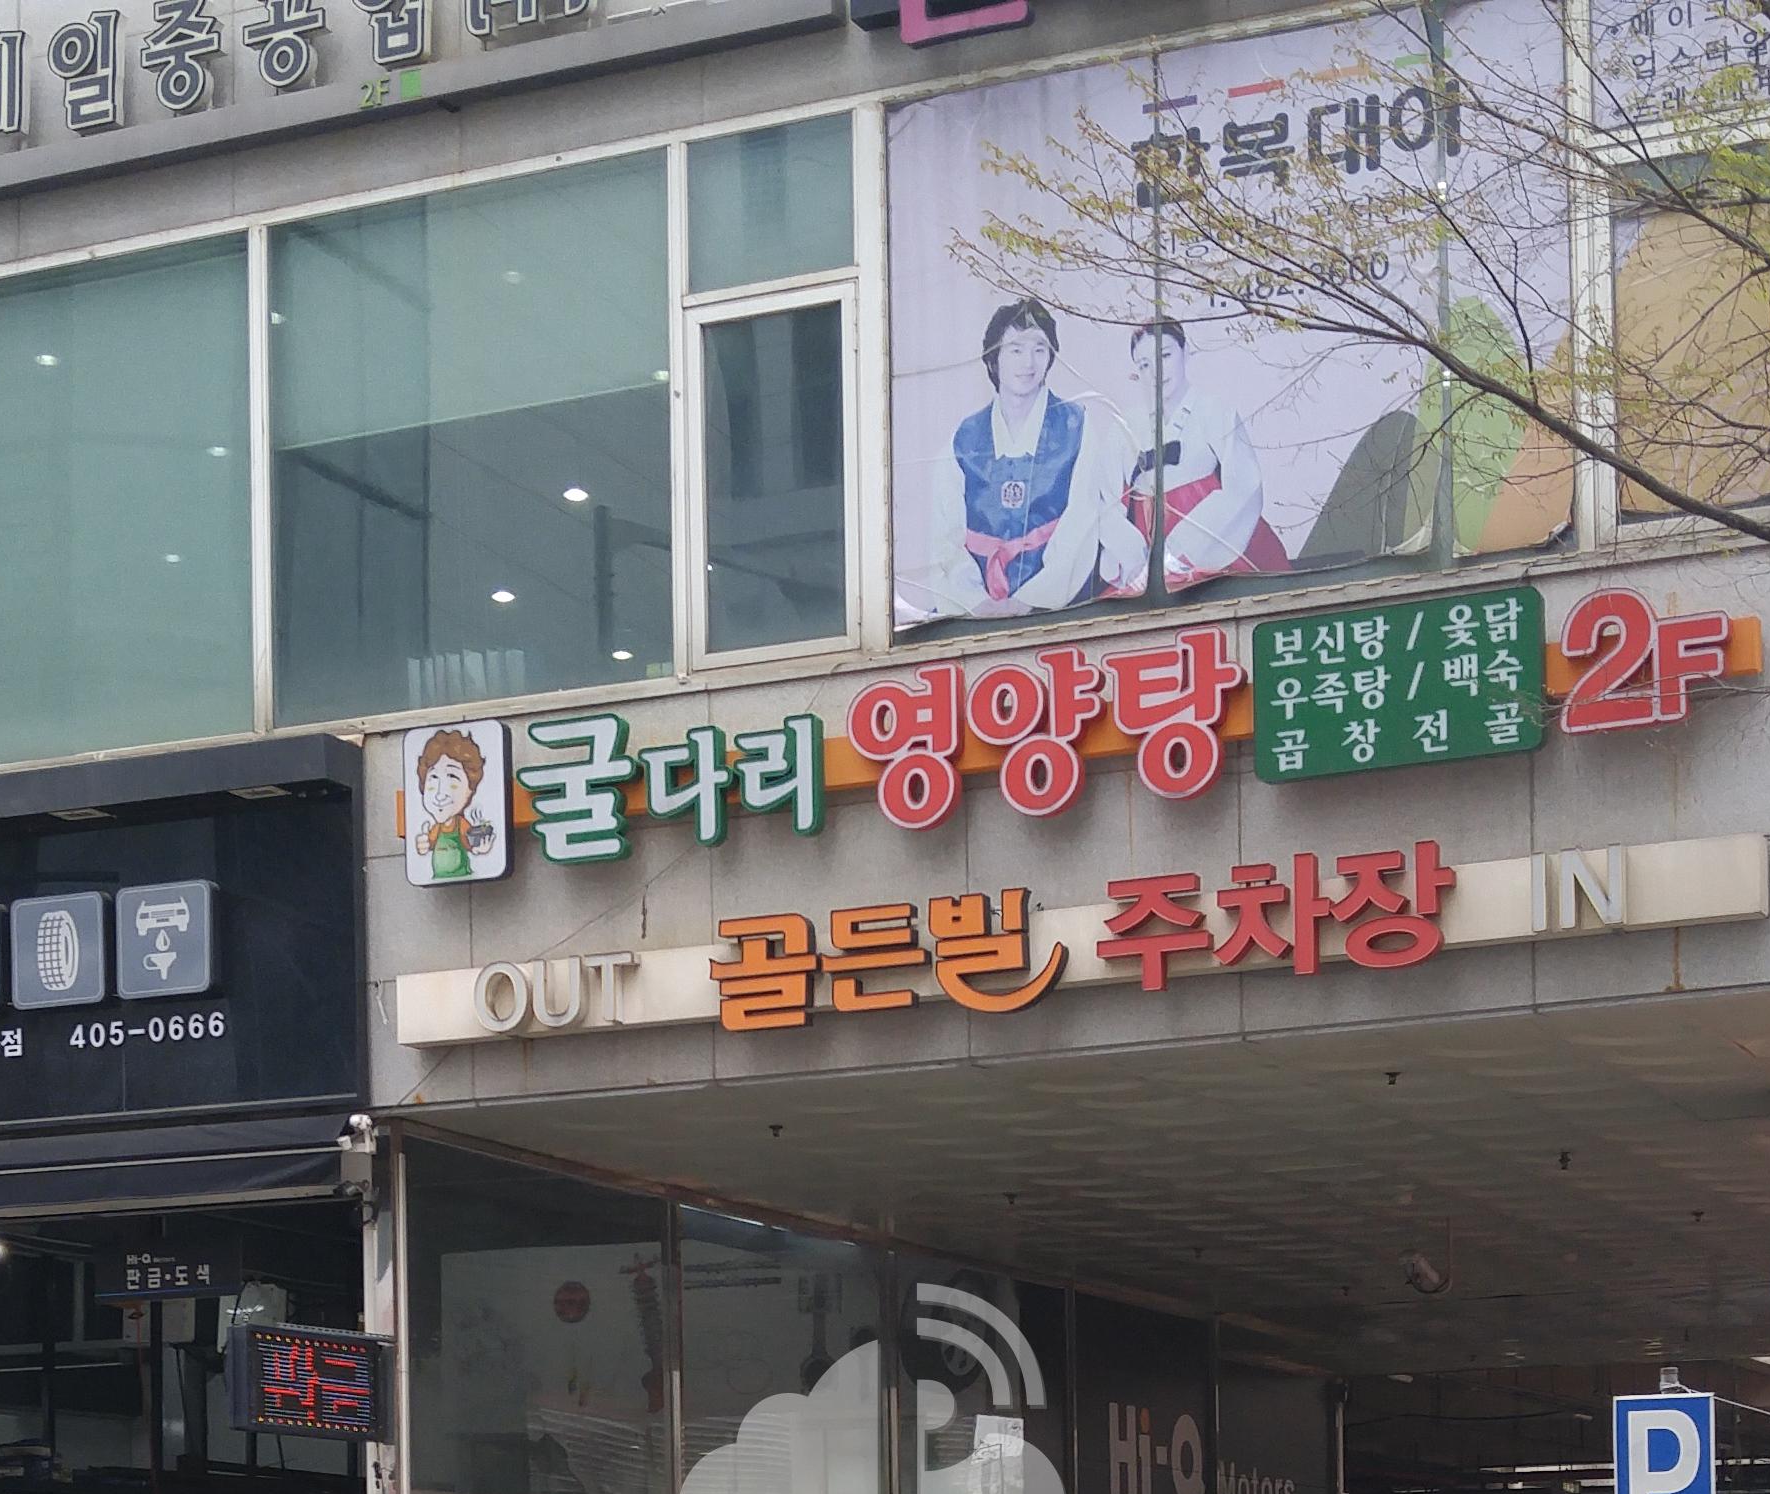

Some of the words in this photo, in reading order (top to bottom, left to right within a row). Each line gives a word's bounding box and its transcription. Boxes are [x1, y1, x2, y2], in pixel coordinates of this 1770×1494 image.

[360, 79, 390, 110] 2F
[1269, 616, 1390, 667] 보신탕
[1269, 667, 1391, 720] 우족탕
[1442, 654, 1524, 697] 백숙
[516, 711, 824, 865] 굴다리
[847, 626, 1241, 831] 영양탕
[1560, 587, 1731, 736] 2F
[473, 953, 638, 1034] OUT
[709, 886, 1067, 1031] 골든빌
[1097, 841, 1455, 991] 주차장
[1529, 842, 1627, 935] IN
[70, 1011, 227, 1050] 405-0666
